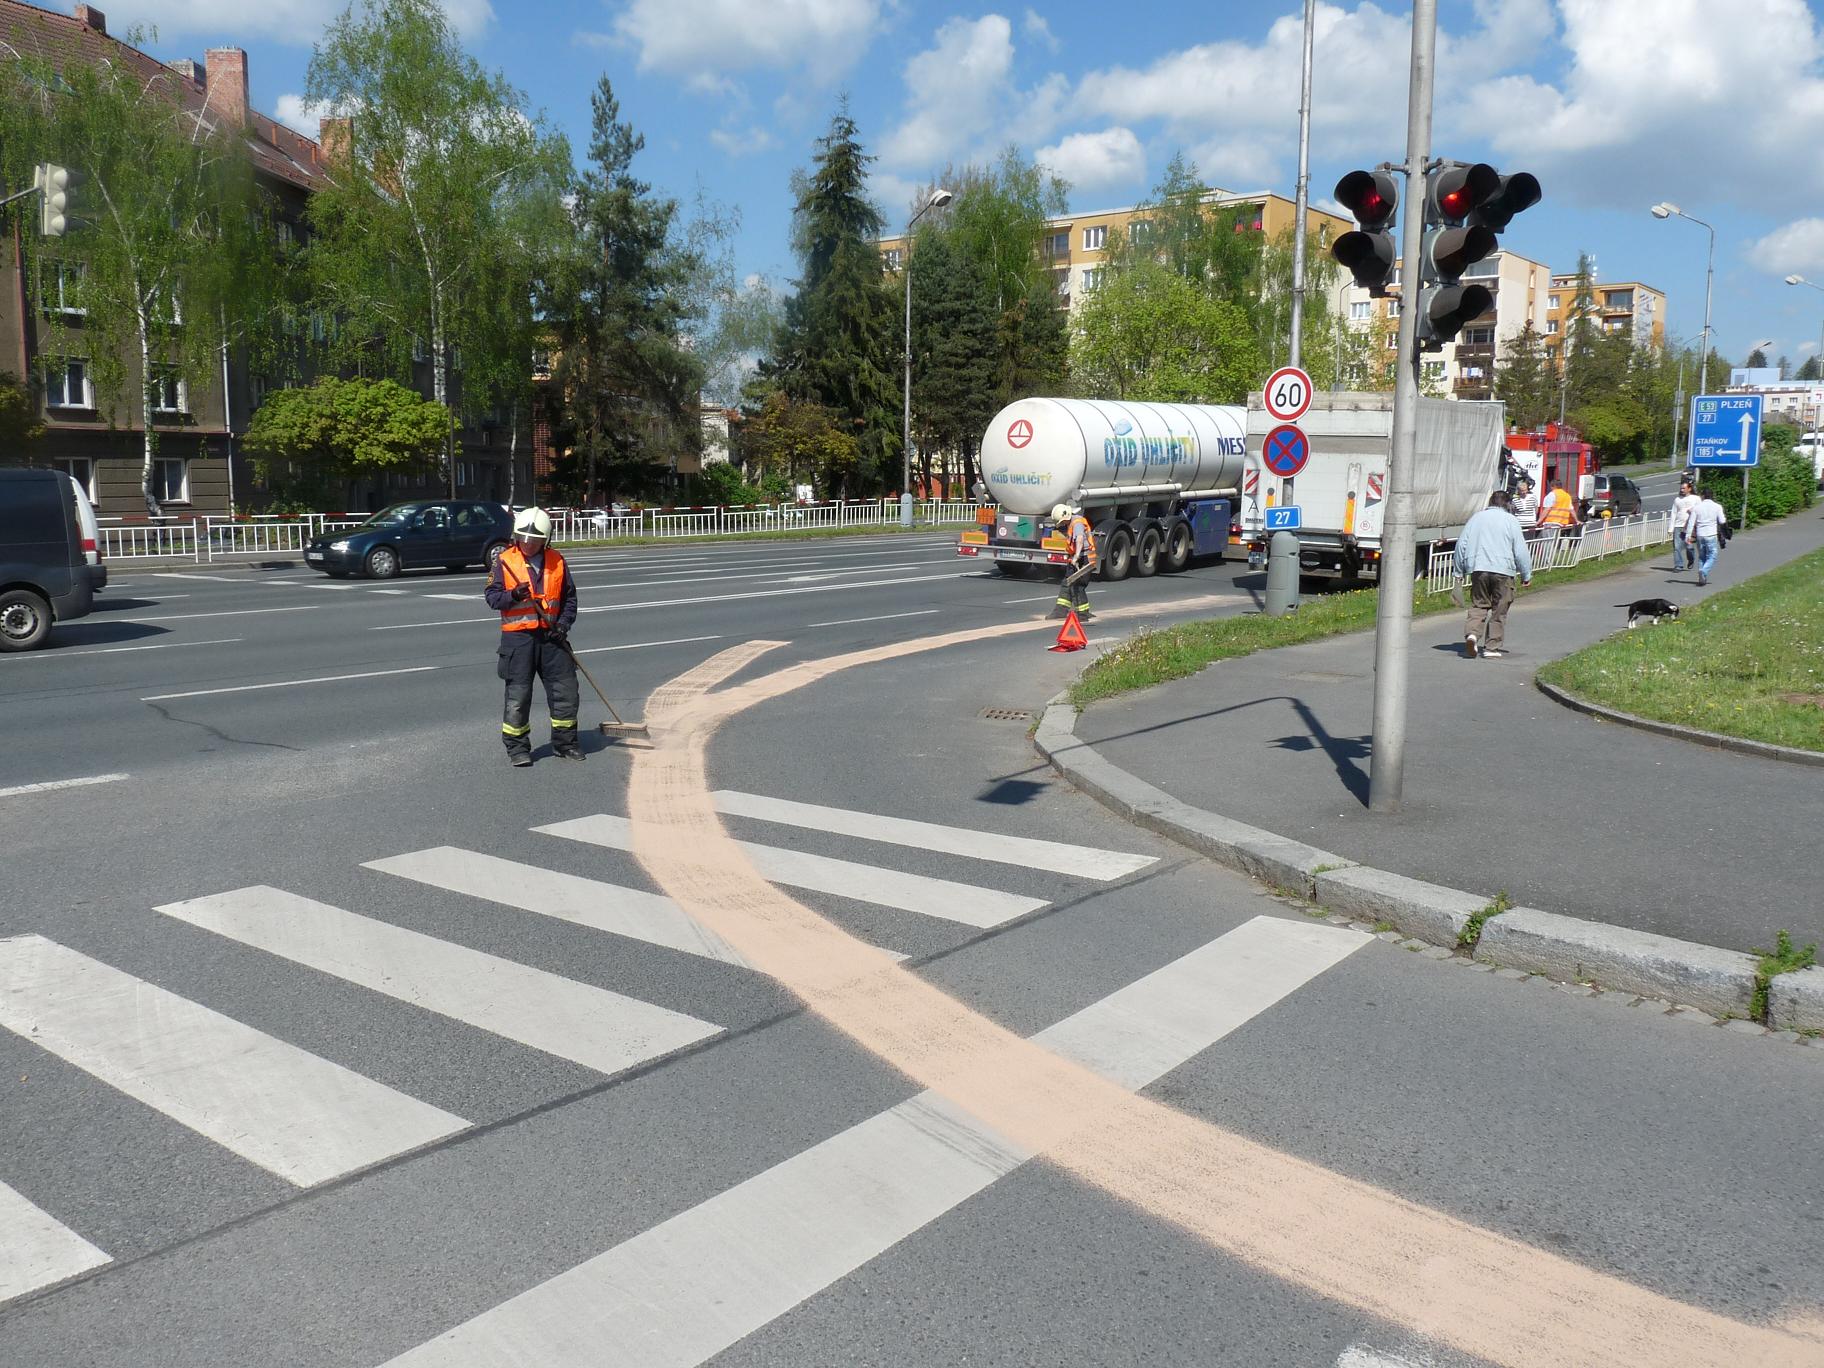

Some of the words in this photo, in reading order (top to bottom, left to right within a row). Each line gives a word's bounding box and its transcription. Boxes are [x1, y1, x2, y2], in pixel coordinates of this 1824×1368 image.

[1275, 383, 1301, 407] 60
[1721, 399, 1752, 408] PLZEŇ
[1702, 414, 1712, 422] 27
[1104, 437, 1137, 467] OXID
[991, 473, 1009, 485] OXID
[1248, 500, 1260, 513] A
[1275, 511, 1291, 525] 27
